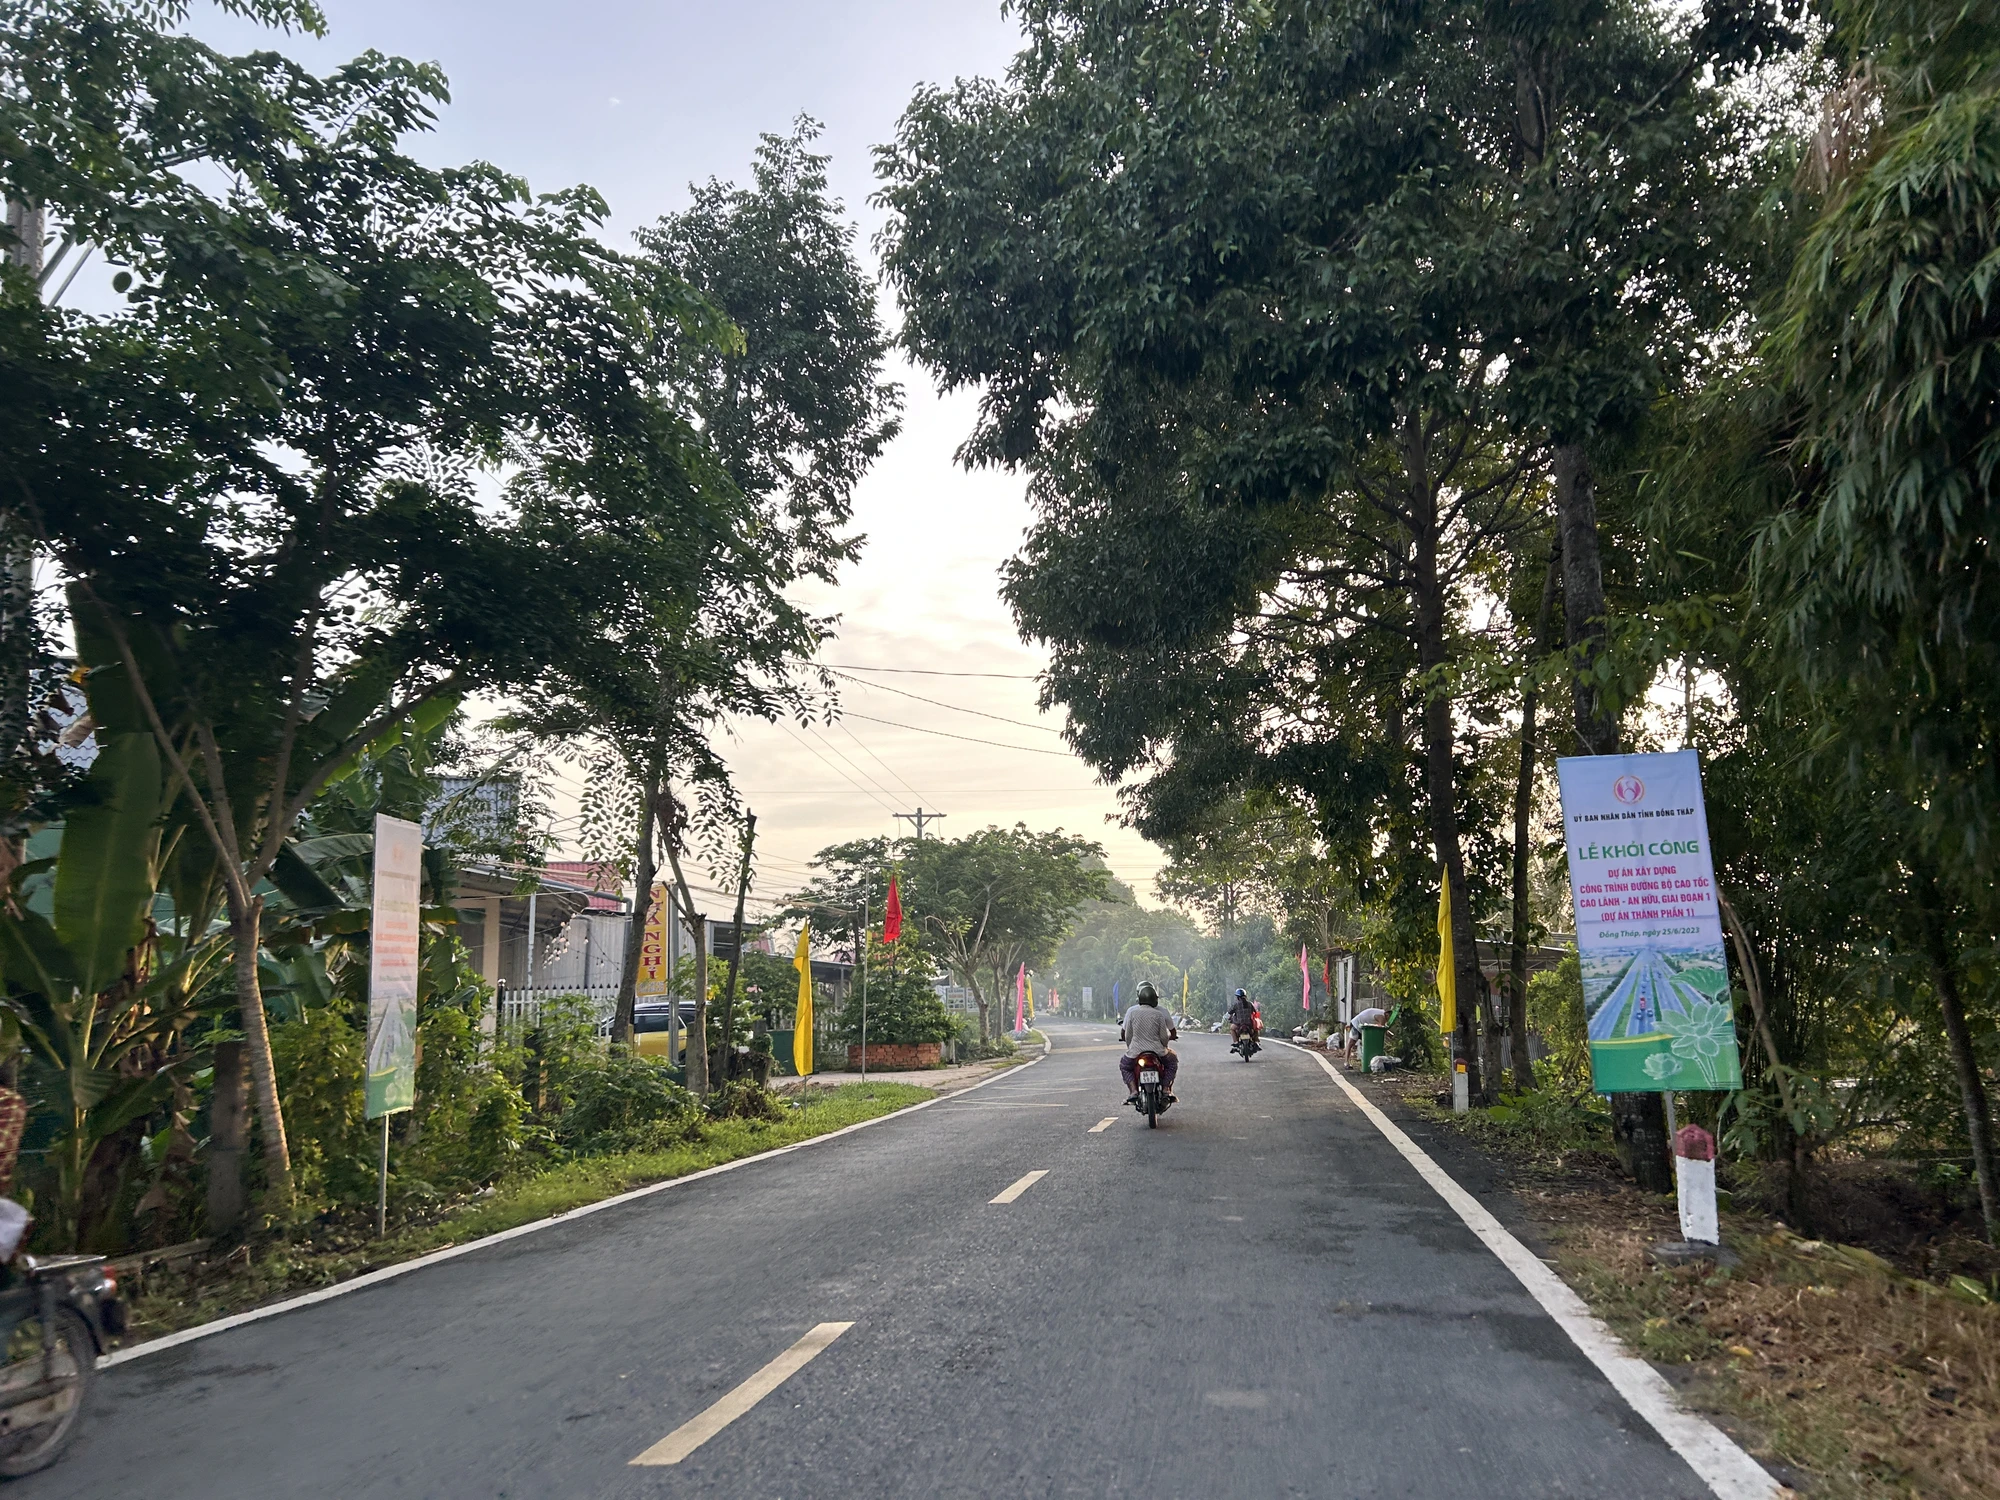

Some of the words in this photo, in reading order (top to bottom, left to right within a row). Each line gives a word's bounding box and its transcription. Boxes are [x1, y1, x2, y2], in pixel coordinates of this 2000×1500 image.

[1600, 812, 1620, 820] NHÂN
[1622, 811, 1636, 819] DÂN
[1676, 807, 1694, 816] THÁP
[1578, 842, 1600, 860] LỄ
[1602, 840, 1644, 858] KHỞI
[1648, 839, 1700, 856] CÔNG
[1608, 869, 1620, 880] DỰ
[1622, 868, 1634, 877] ÁN
[1636, 866, 1651, 876] XÂY
[1654, 866, 1676, 876] DỰNG
[1580, 884, 1602, 894] CÔNG
[1604, 882, 1628, 892] TRÌNH
[1630, 880, 1659, 891] ĐƯỜNG
[1662, 879, 1672, 891] BỘ
[1674, 880, 1691, 888] CAO
[1693, 876, 1709, 888] TỐC
[1580, 898, 1596, 908] CAO
[1628, 896, 1640, 905] AN
[1662, 894, 1678, 903] GIAI
[1680, 893, 1704, 904] ĐOẠN
[1706, 892, 1710, 901] 1
[1601, 912, 1616, 922] (DỰ
[1642, 928, 1660, 938] ngày
[1662, 926, 1700, 935] 25/6/2023
